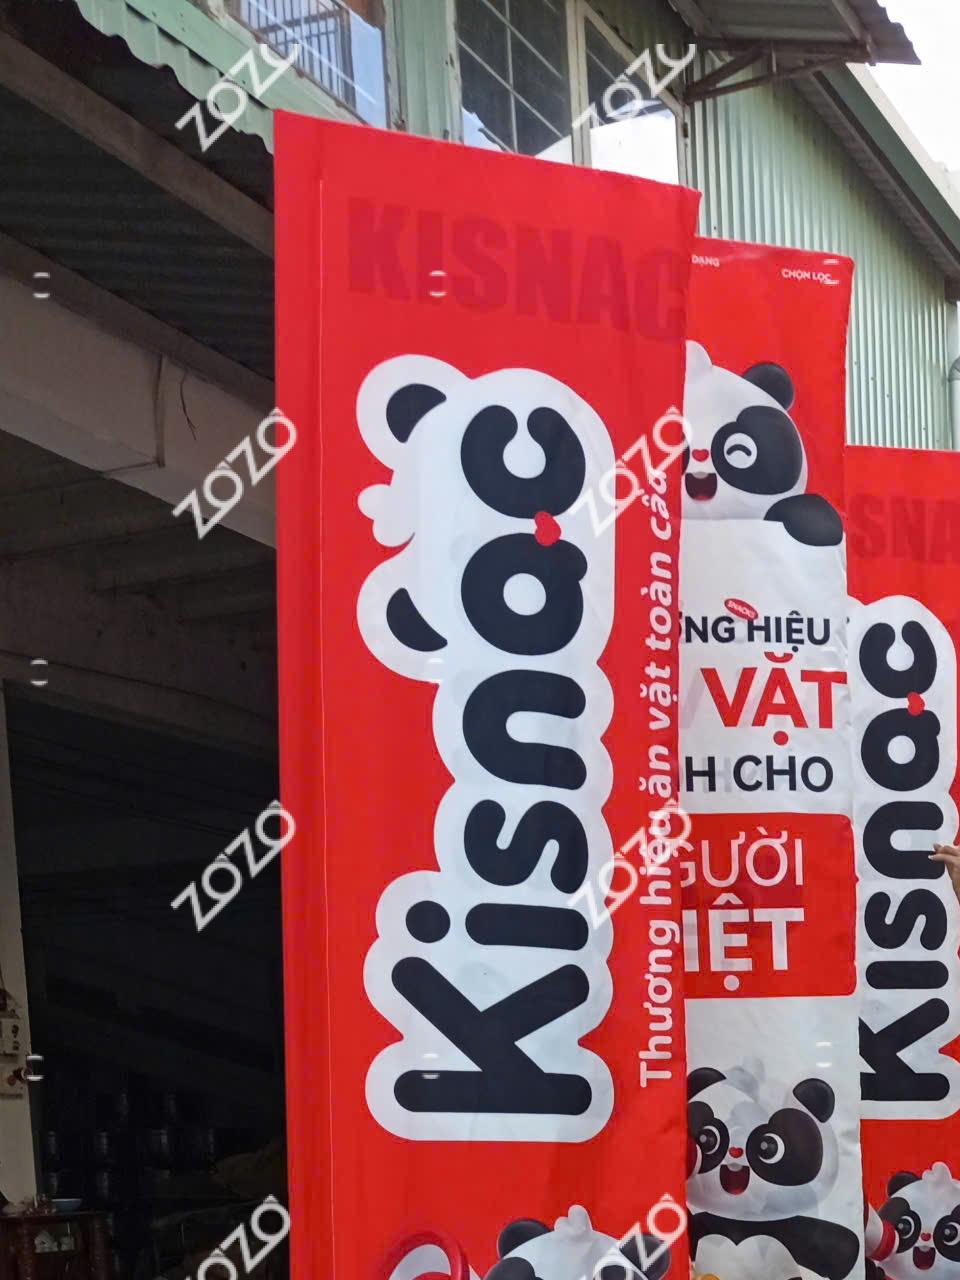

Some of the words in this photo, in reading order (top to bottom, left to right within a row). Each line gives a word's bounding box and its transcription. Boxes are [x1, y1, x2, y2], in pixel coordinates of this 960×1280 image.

[347, 196, 688, 342] KISNAC
[640, 551, 673, 651] toàn
[747, 610, 831, 653] HIỆU
[700, 651, 848, 746] VẶT
[390, 404, 594, 1114] Kisnac
[639, 744, 673, 799] ăn
[733, 755, 834, 793] CHO
[682, 892, 805, 991] IỆT
[639, 919, 680, 1088] Thương
